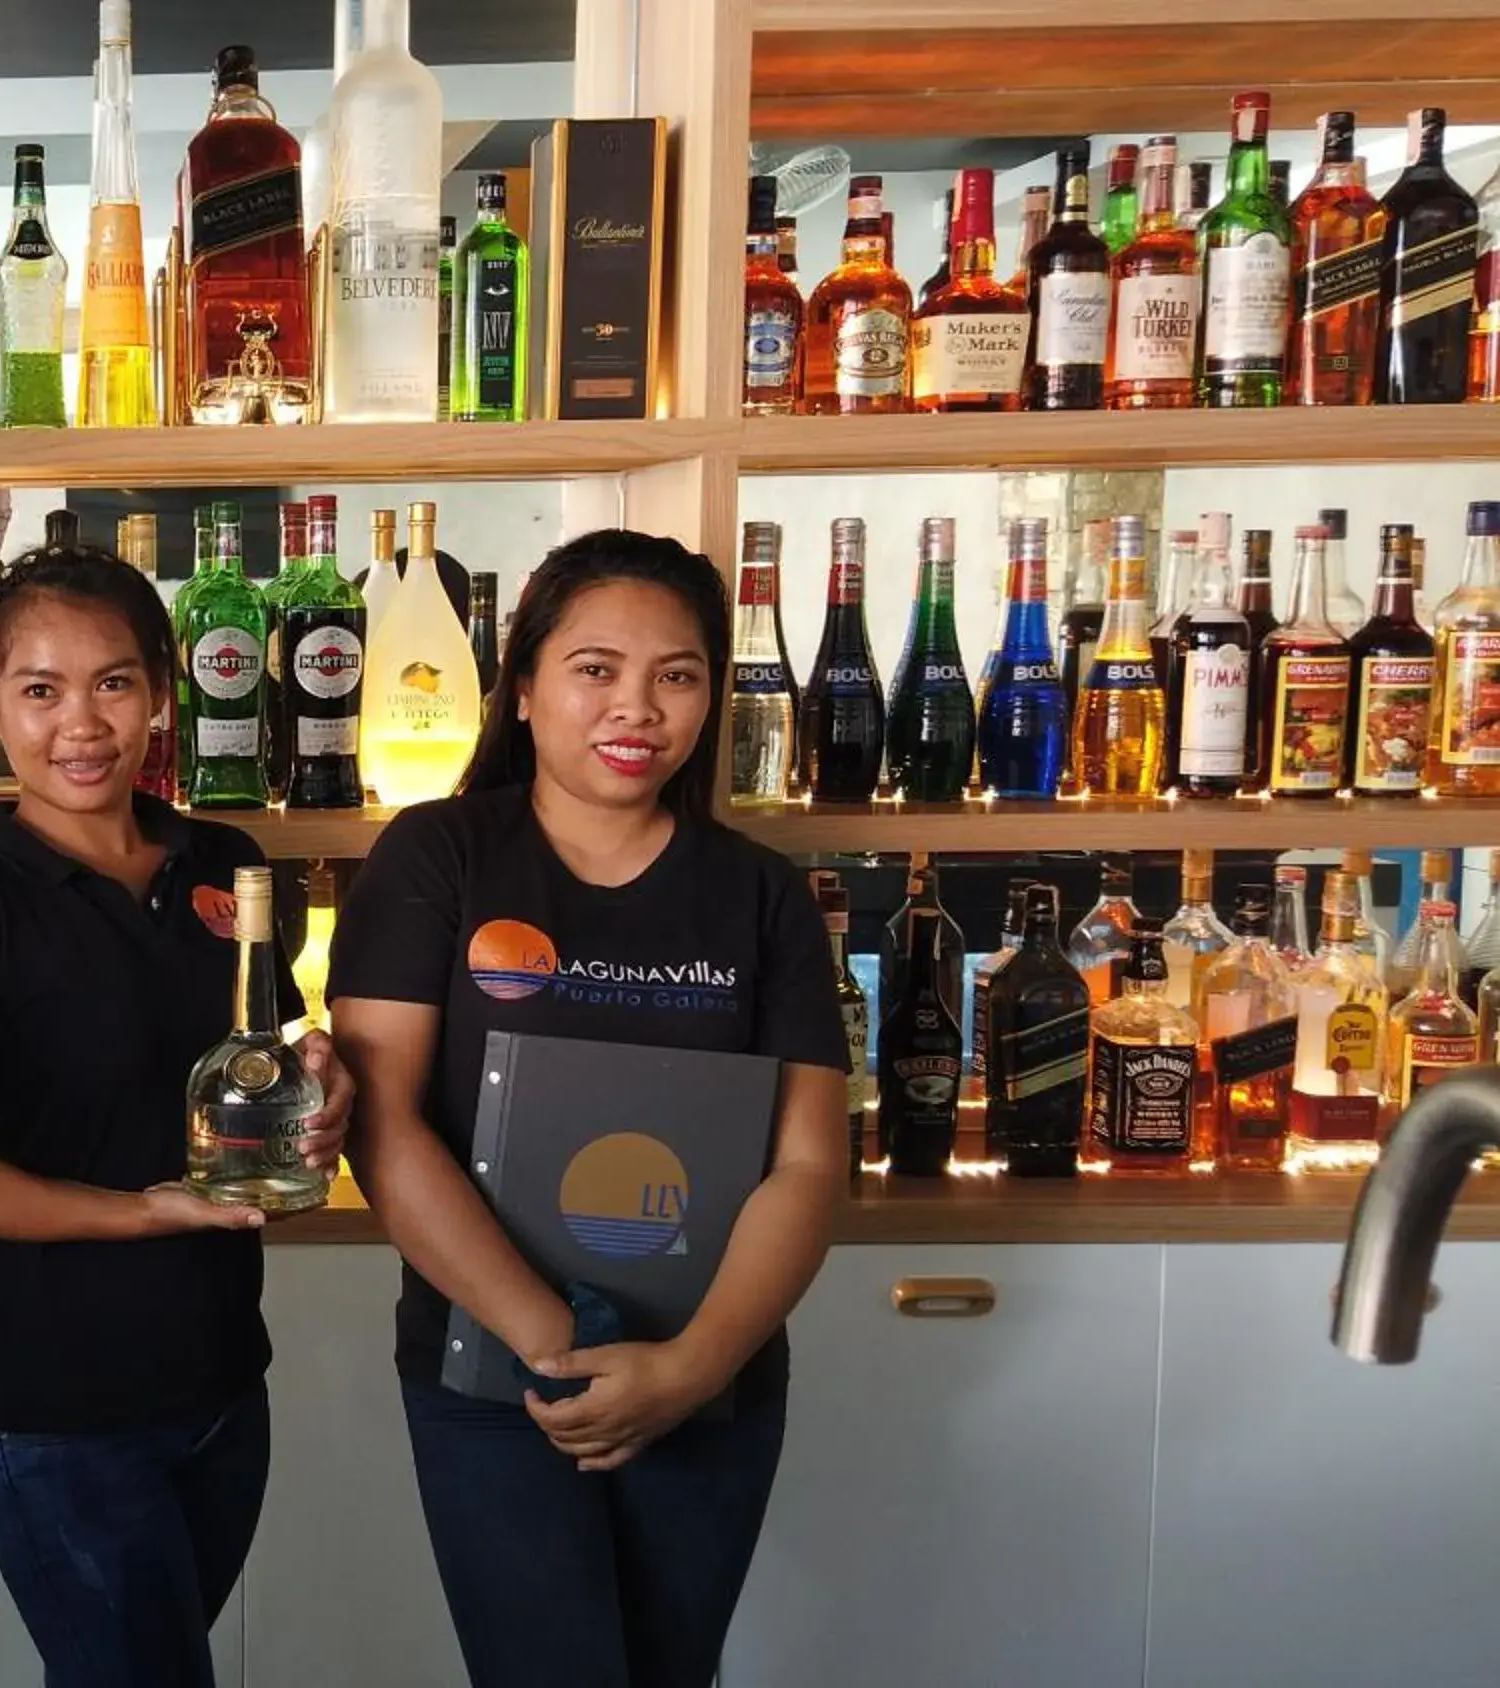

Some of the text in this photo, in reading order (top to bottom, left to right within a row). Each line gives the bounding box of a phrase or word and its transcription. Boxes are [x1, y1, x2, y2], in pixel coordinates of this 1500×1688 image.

[1314, 269, 1345, 288] LACK
[1146, 299, 1190, 319] WILD
[947, 321, 1022, 335] Maker's
[1132, 315, 1192, 339] TURKE
[968, 337, 1020, 351] Mark
[201, 657, 258, 670] MARTINI
[301, 656, 358, 669] MARTINI
[736, 667, 783, 682] BOLS
[826, 667, 874, 683] BOLS
[1013, 665, 1060, 681] BOLS
[1107, 665, 1155, 680] BOLS
[522, 952, 550, 969] LA
[553, 981, 739, 1013] Puerto Galera
